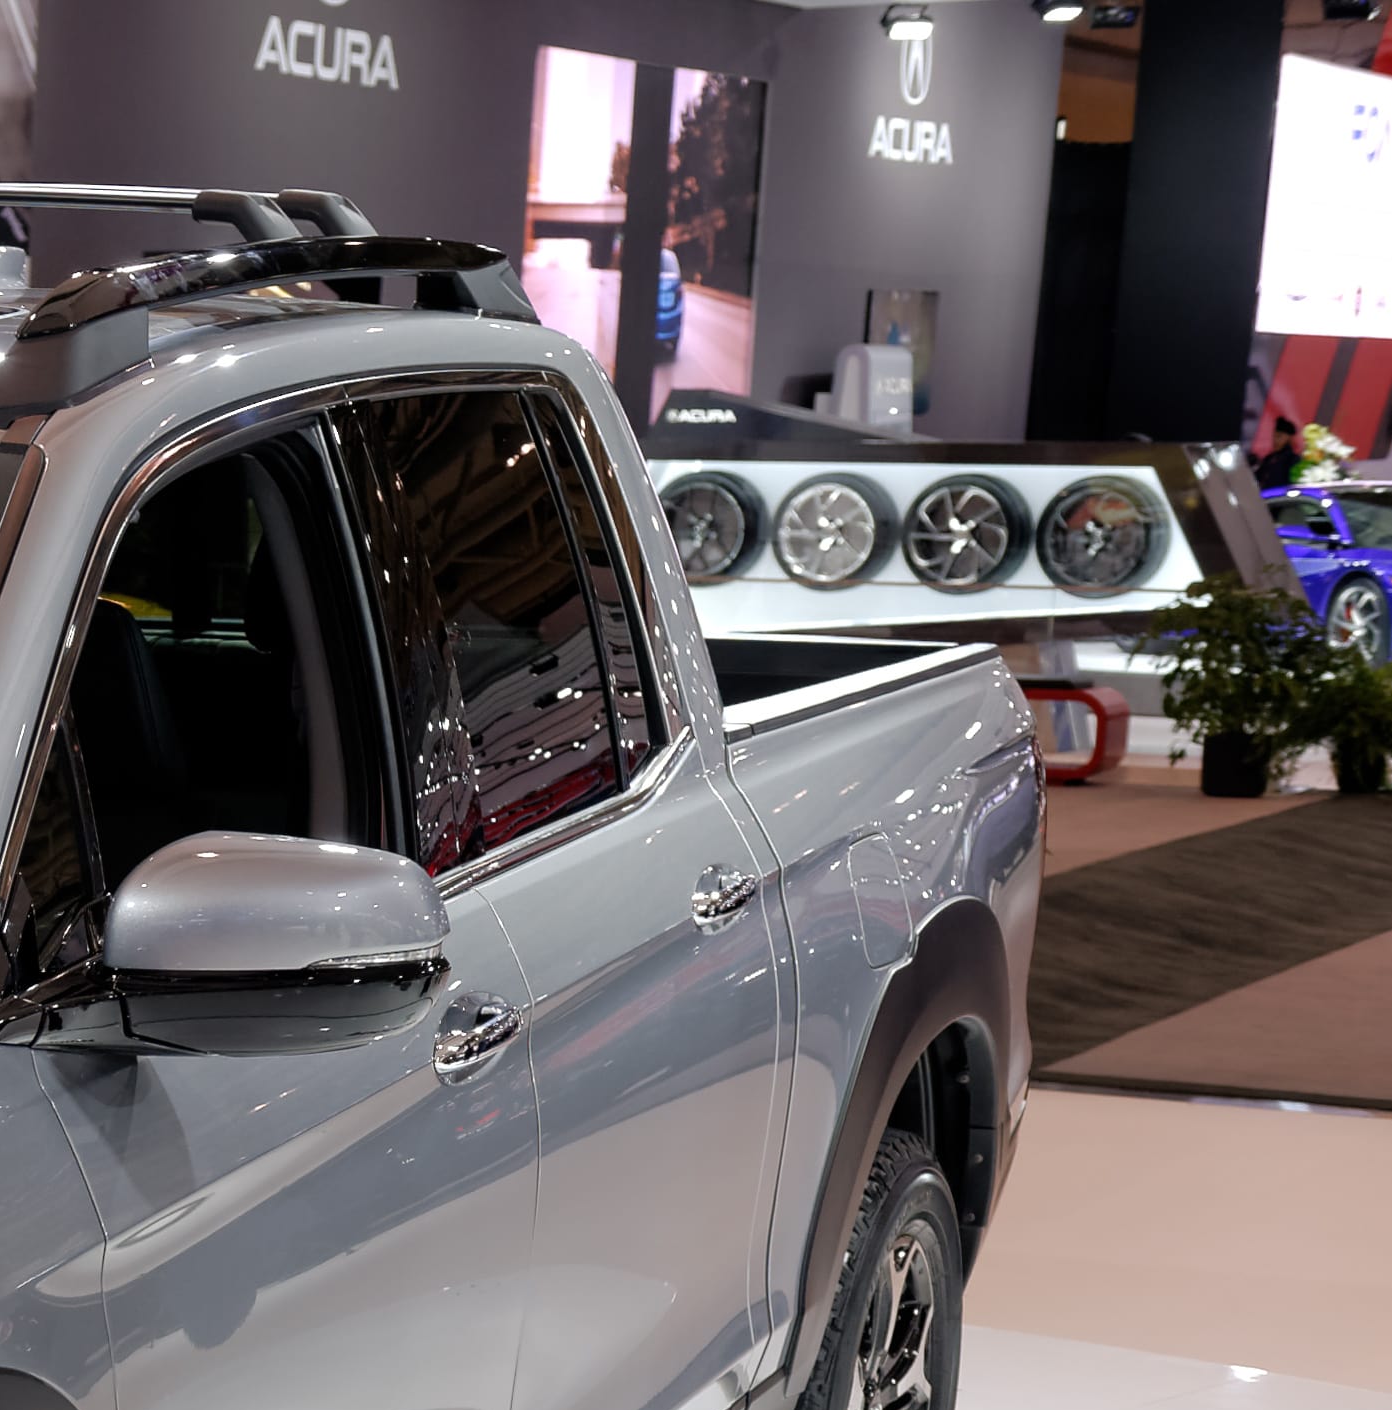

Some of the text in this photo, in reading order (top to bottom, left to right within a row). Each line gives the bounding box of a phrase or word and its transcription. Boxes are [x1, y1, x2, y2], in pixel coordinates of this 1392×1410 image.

[253, 14, 400, 91] ACURA
[867, 115, 953, 165] ACURA
[678, 408, 737, 424] ACURA
